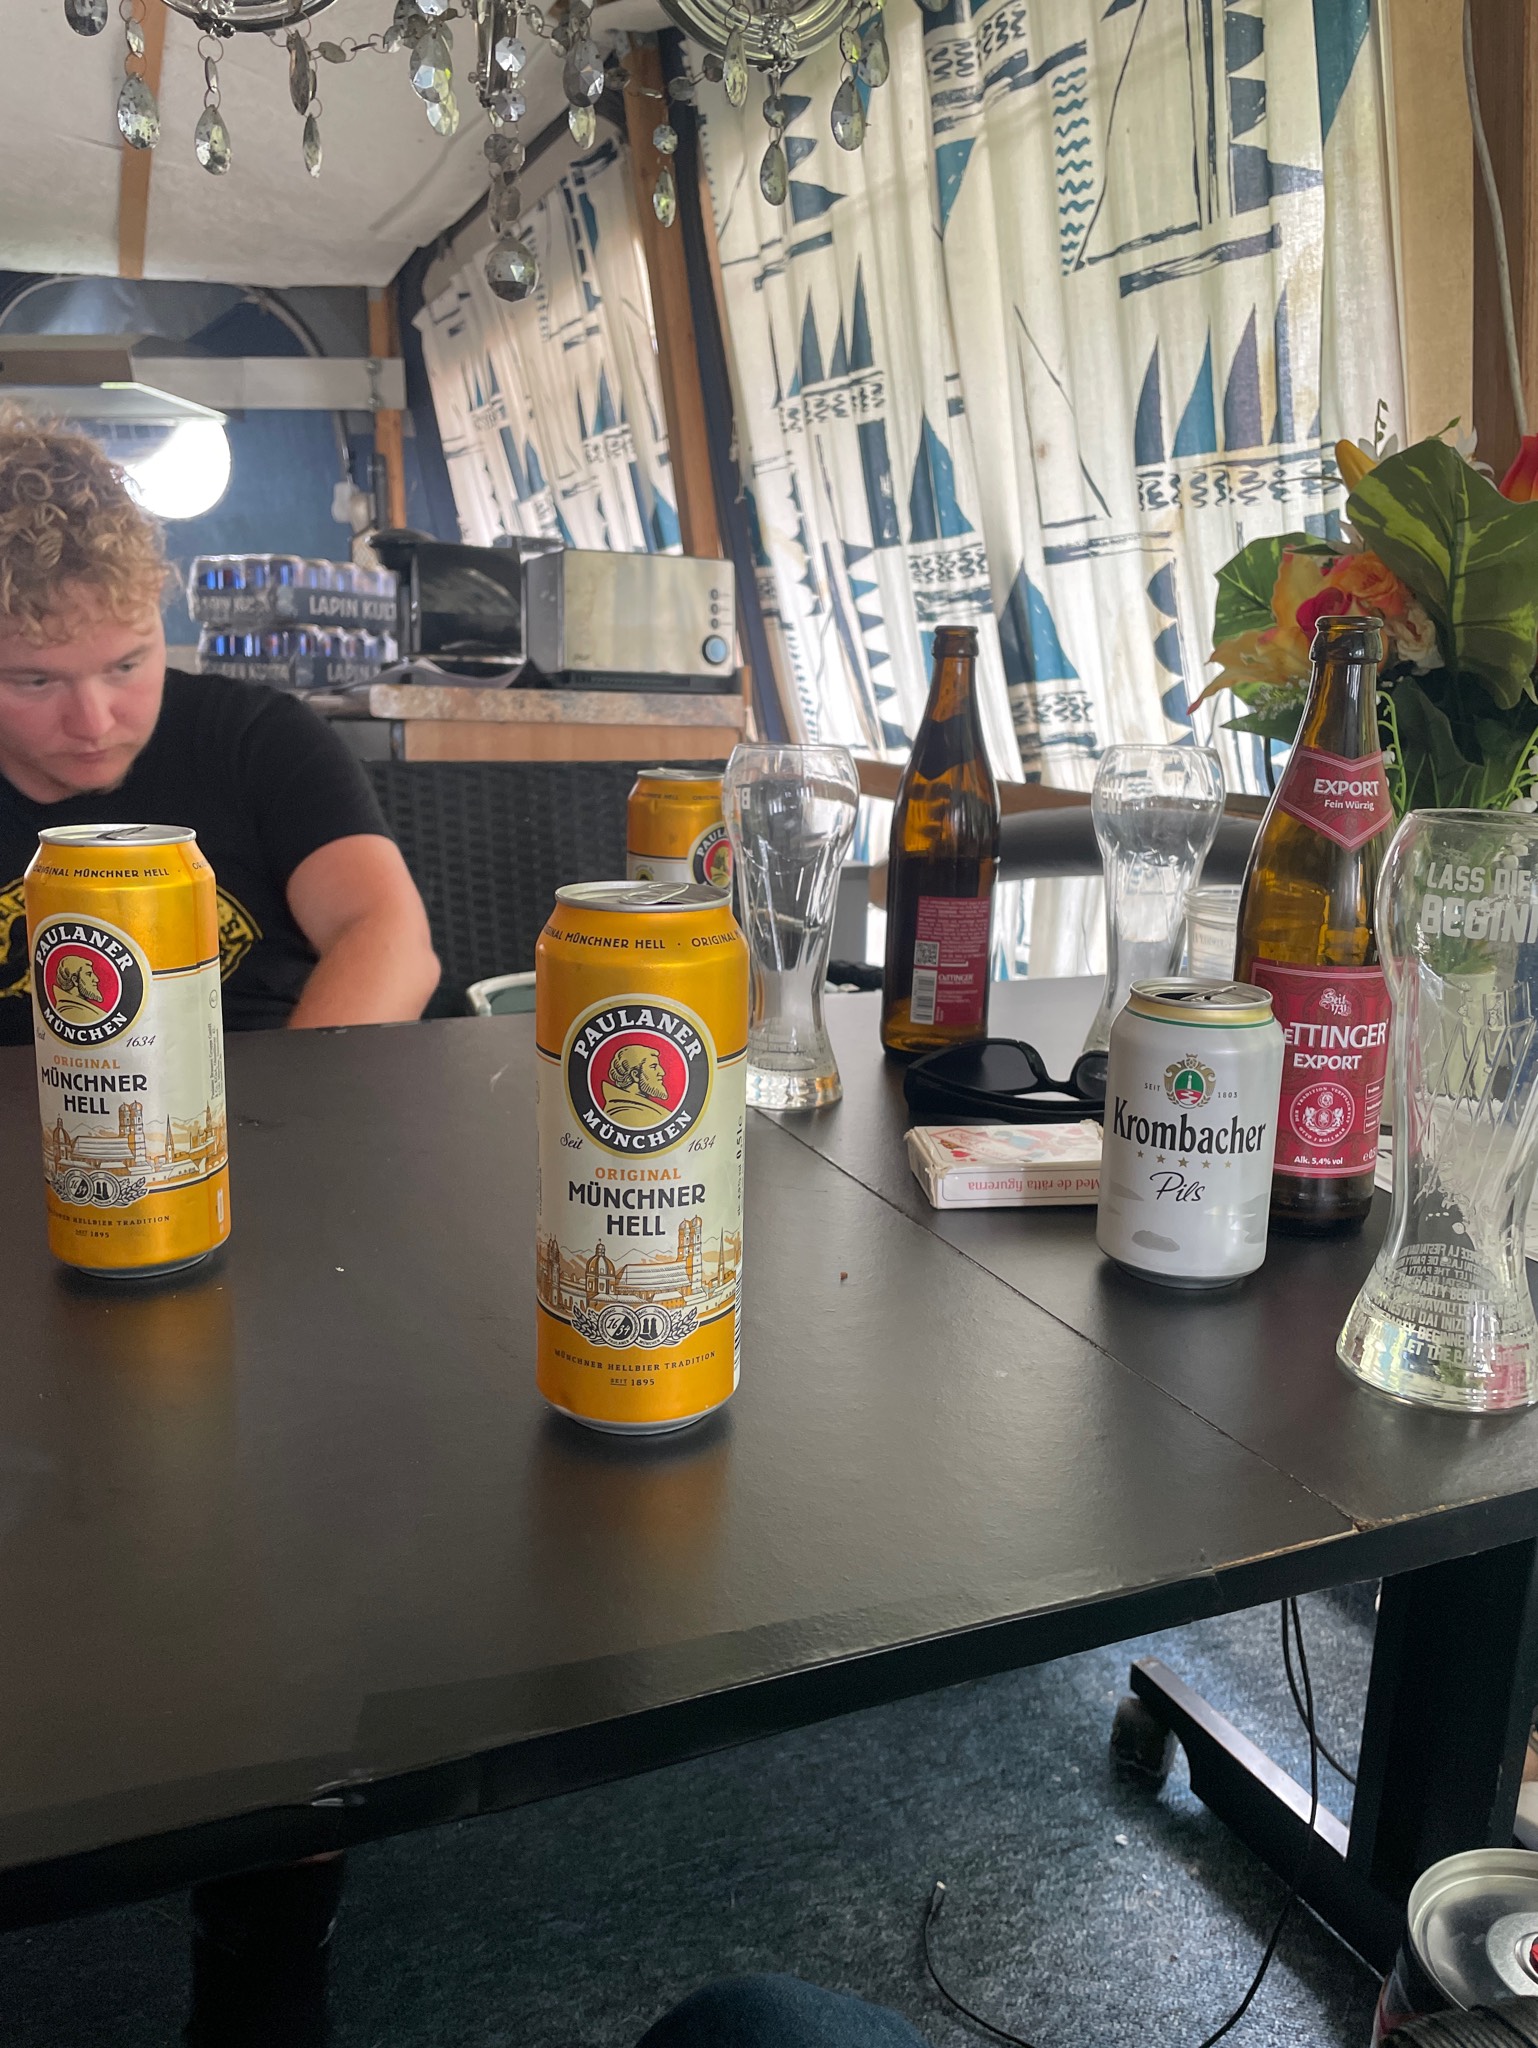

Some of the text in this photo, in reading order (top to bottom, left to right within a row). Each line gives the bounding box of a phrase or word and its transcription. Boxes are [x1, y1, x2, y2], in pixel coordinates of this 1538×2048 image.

[309, 595, 358, 618] LAPIN
[1313, 778, 1379, 796] EXPORT
[1324, 799, 1375, 812] Fein Würzig
[32, 863, 170, 879] ORIGINAL MÜNCHNER HELL
[1426, 862, 1532, 897] LASS DIE
[35, 925, 135, 973] PAULANER
[564, 931, 630, 949] MÜNCHNER
[634, 938, 666, 950] HELL
[691, 931, 736, 948] ORIGINAL
[43, 1008, 129, 1043] MÜNCHEN
[573, 1008, 703, 1062] PAULANER
[1284, 1021, 1387, 1049] ETTINGER
[125, 1034, 157, 1049] 1634
[53, 1054, 121, 1070] ORIGINAL
[1293, 1052, 1362, 1071] EXPORT
[40, 1066, 148, 1093] MÜNCHNER
[1144, 1082, 1239, 1100] SEIT 1803
[63, 1093, 111, 1116] HELL
[582, 1109, 693, 1151] MÜNCHEN
[1113, 1096, 1267, 1155] Krombacher
[559, 1131, 717, 1153] Seit 1634
[1293, 1155, 1310, 1164] Alk.
[1311, 1156, 1331, 1166] 5,4%
[1332, 1157, 1344, 1165] vol
[594, 1166, 682, 1182] ORIGINAL
[968, 1177, 1023, 1193] figurerna
[1027, 1179, 1054, 1191] rätta
[1057, 1179, 1072, 1190] de
[1150, 1171, 1206, 1203] Pils
[568, 1181, 706, 1211] MÜNCHNER
[116, 1214, 170, 1227] TRADITION
[606, 1213, 666, 1237] HELL
[90, 1229, 110, 1238] 1895
[553, 1347, 717, 1372] MÜNCHNER HELLBIER TRADITION
[630, 1377, 656, 1387] 1895
